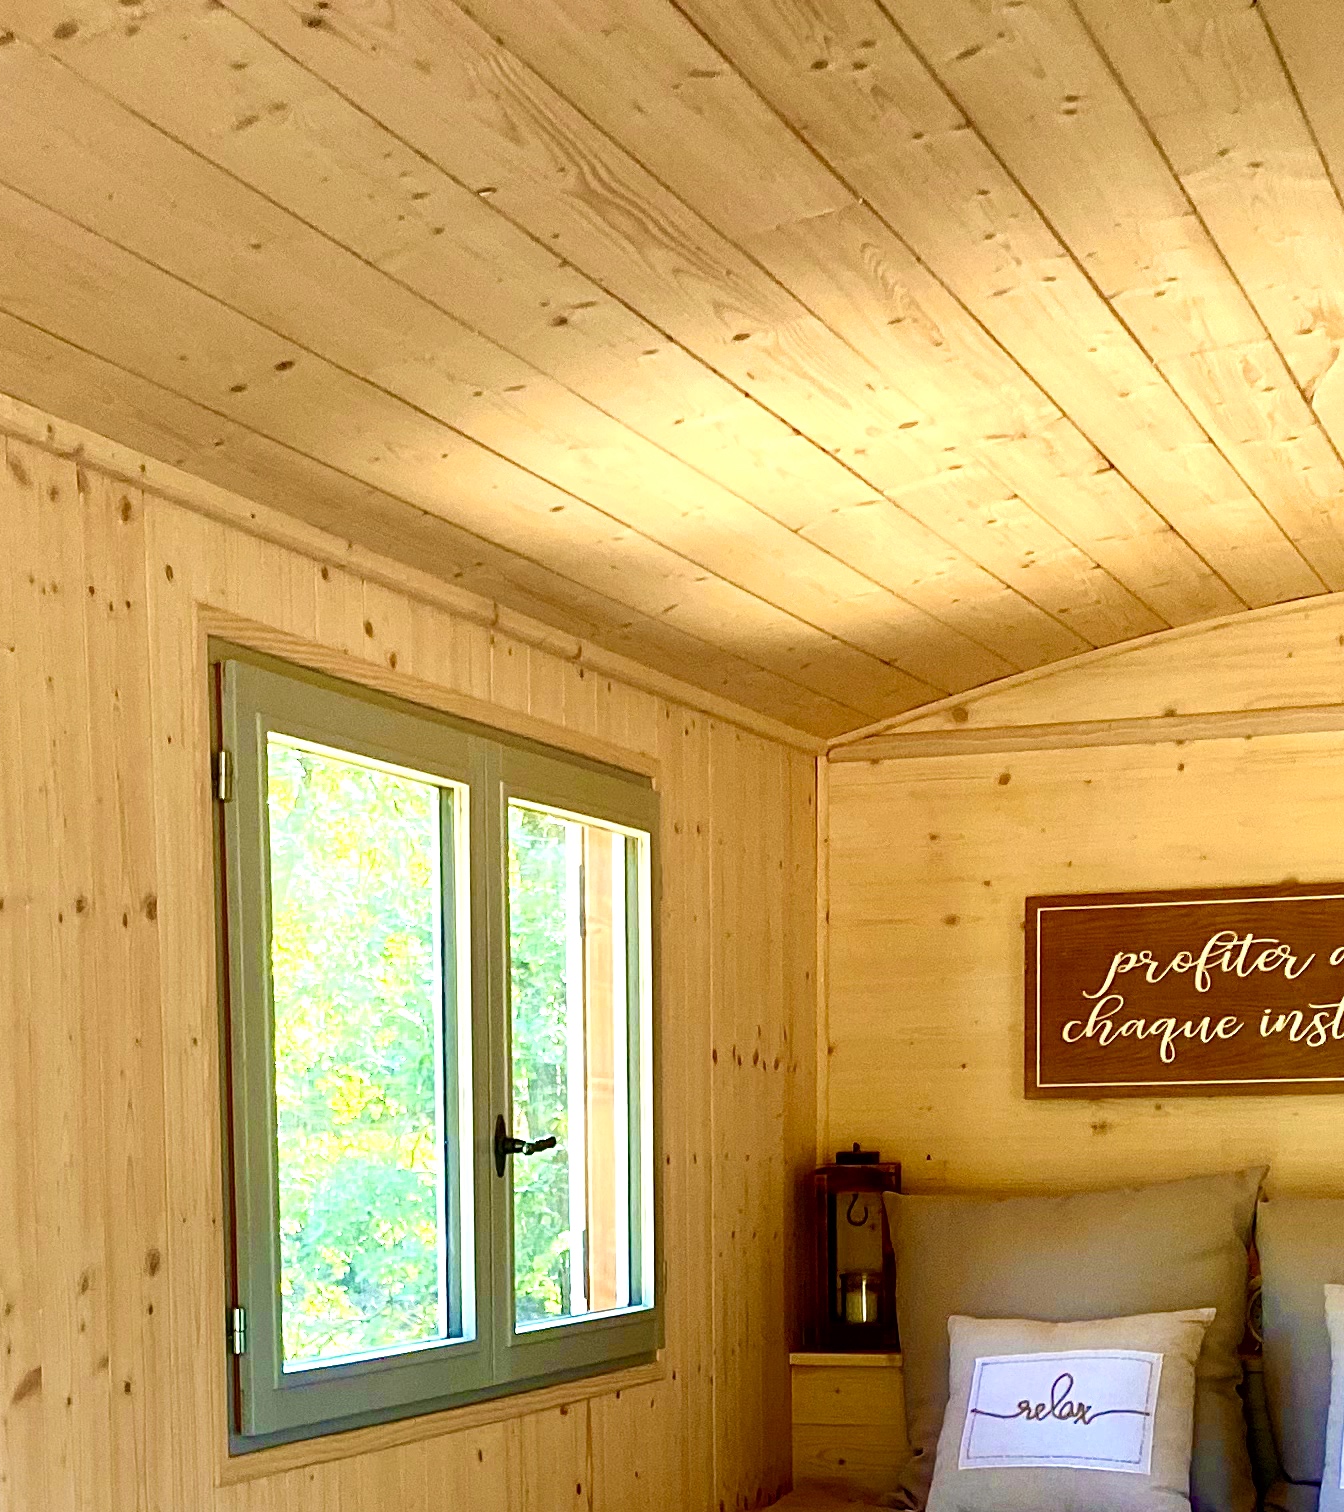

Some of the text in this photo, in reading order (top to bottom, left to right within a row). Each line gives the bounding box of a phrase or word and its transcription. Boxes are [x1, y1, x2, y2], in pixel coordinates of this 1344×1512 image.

[1082, 929, 1316, 999] profiter
[1061, 993, 1244, 1063] chaque
[998, 1372, 1111, 1426] relax
